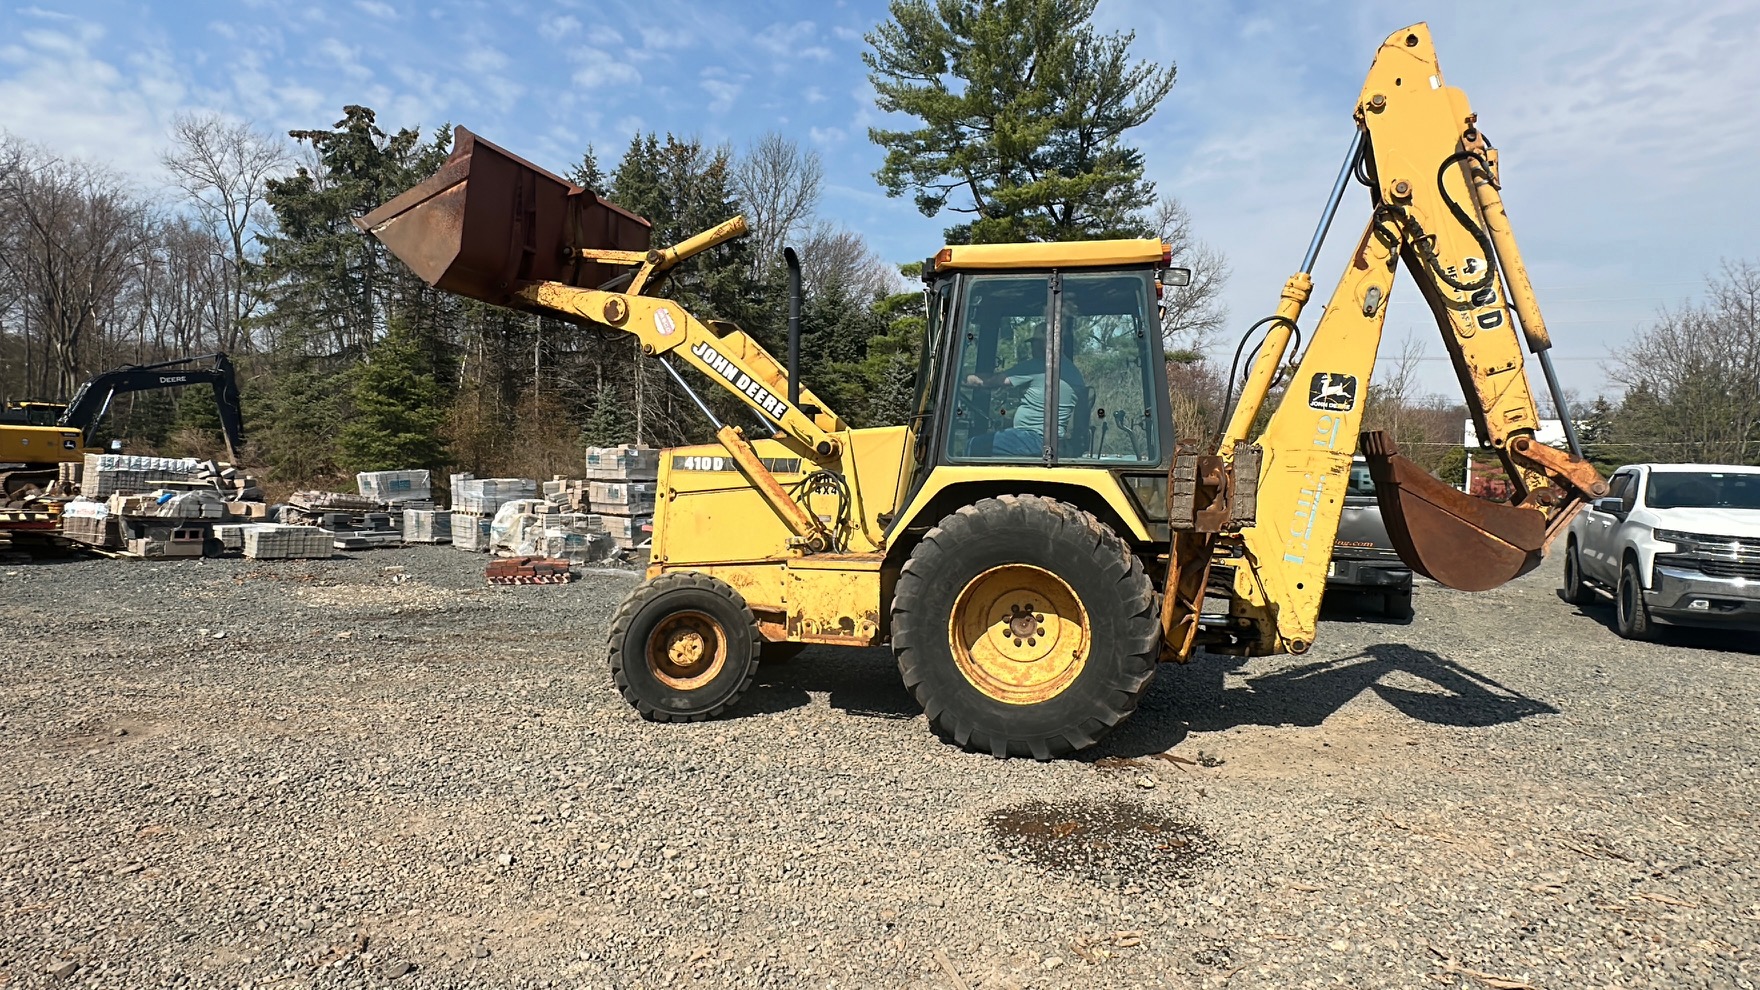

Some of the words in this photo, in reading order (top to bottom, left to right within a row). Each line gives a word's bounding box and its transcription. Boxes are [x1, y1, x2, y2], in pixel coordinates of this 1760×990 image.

[159, 375, 187, 384] DEERE
[692, 342, 739, 382] JOHN
[736, 373, 787, 419] DEERE
[684, 456, 712, 470] 410
[712, 456, 724, 471] D
